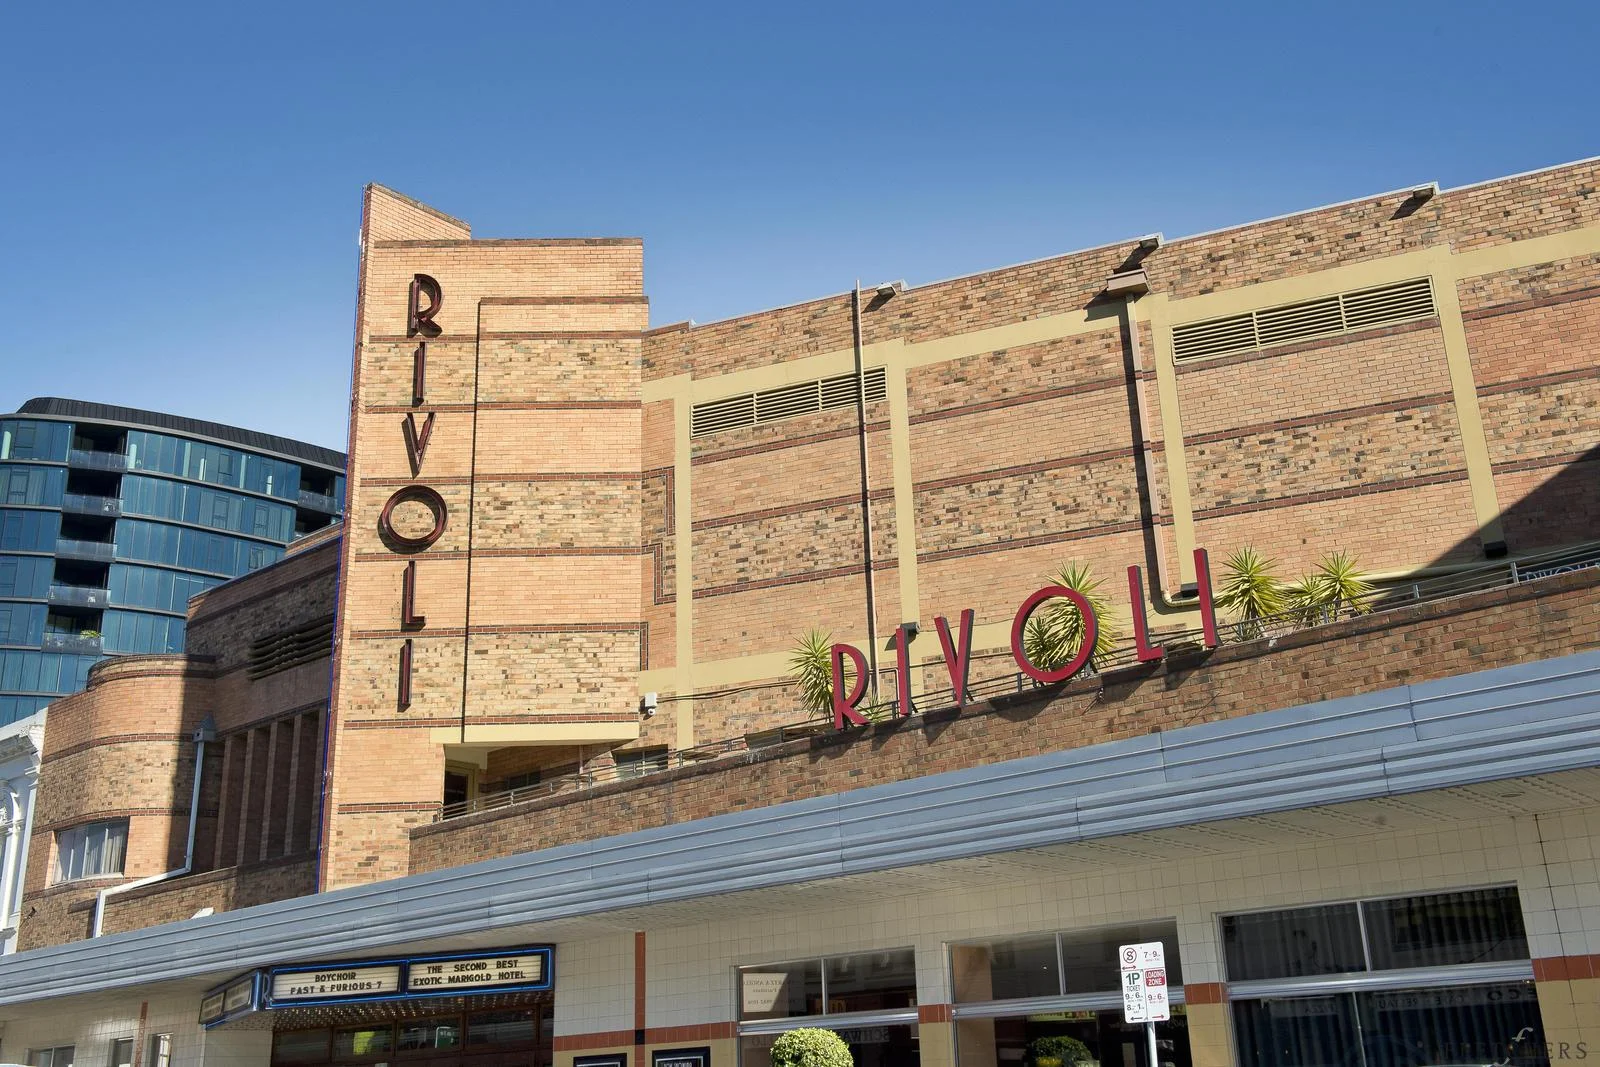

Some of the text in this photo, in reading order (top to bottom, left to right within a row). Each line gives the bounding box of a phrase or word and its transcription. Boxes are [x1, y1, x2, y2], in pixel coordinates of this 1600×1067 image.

[378, 272, 449, 709] RIVOLI
[830, 546, 1223, 731] RIVOLI
[426, 959, 519, 974] THE SECOND BEST
[314, 971, 357, 983] BOYCHOIR
[413, 970, 526, 987] EXOTIC MARIGOLD HOTEL
[1125, 972, 1141, 985] 1P
[1148, 978, 1163, 986] ZONE
[290, 981, 382, 995] FAST & FURIOUS 7
[1126, 984, 1141, 992] TICKET
